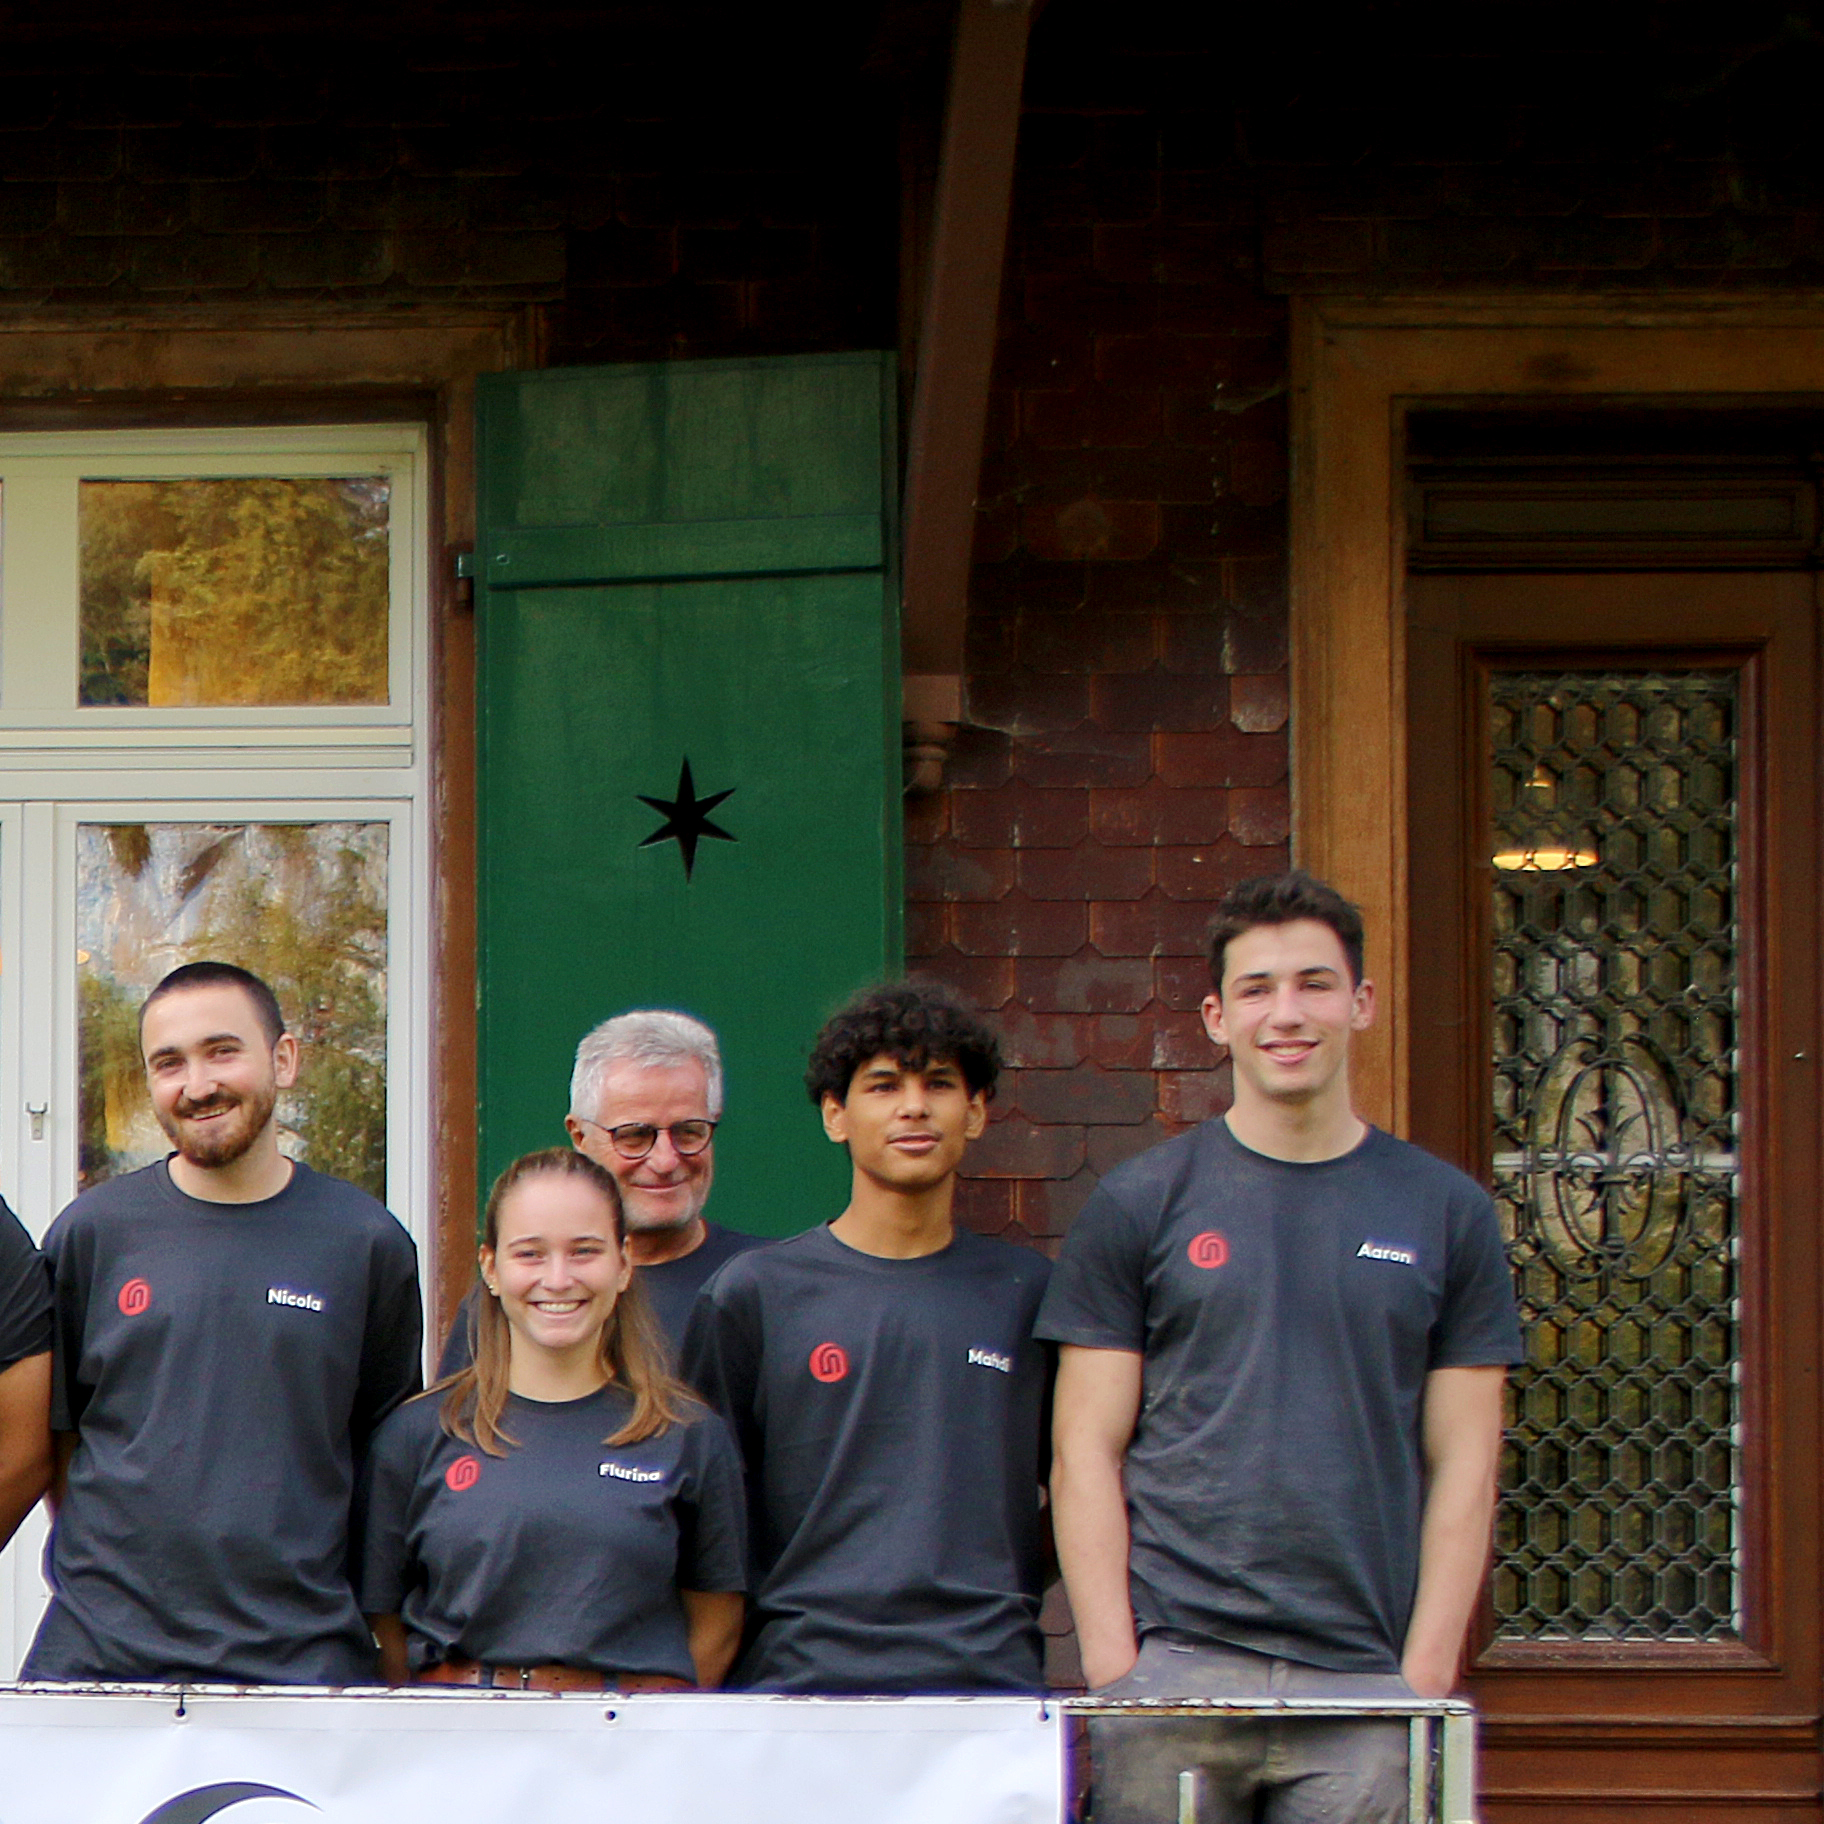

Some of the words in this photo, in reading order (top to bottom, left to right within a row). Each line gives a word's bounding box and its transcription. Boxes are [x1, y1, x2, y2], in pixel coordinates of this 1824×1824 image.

[1356, 1242, 1415, 1266] Aaron
[266, 1288, 323, 1313] Nicola
[598, 1461, 664, 1483] Flurina
